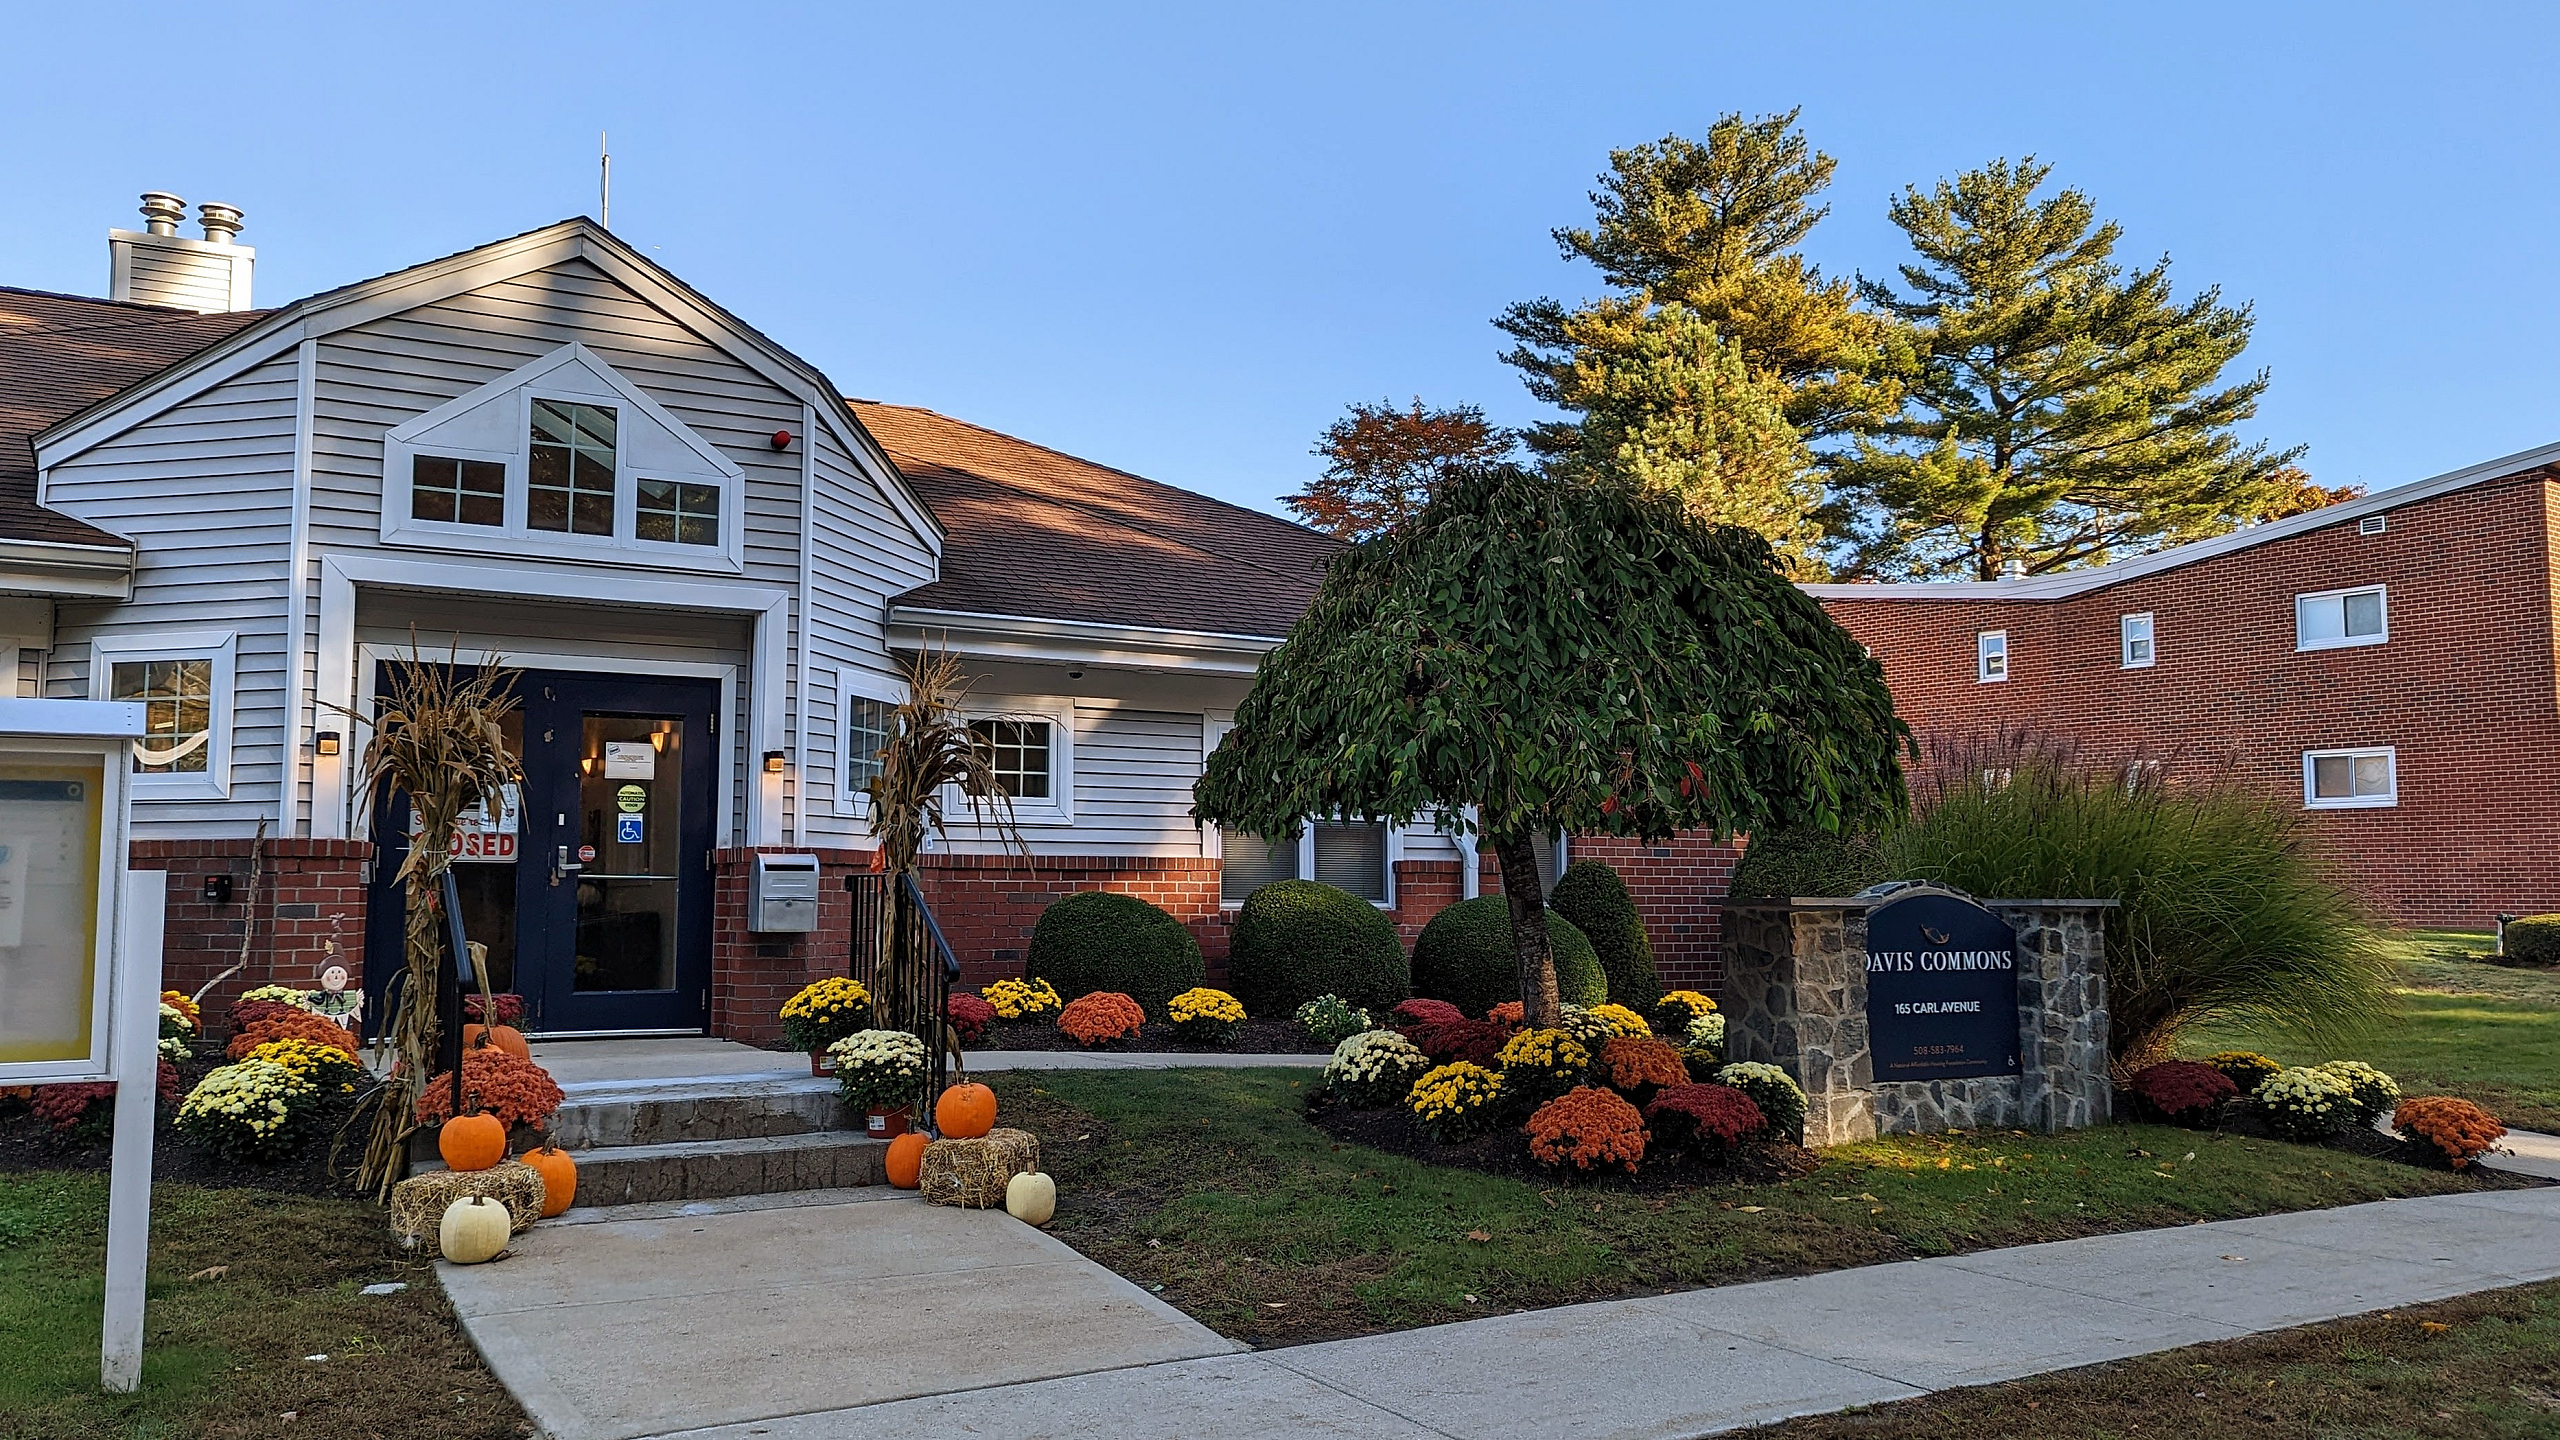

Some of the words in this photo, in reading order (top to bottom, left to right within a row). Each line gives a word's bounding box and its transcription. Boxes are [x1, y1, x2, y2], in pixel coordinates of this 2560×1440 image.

[1920, 950, 2012, 971] COMMONS
[1895, 1003, 1911, 1015] 165
[1912, 1002, 1940, 1014] CARL
[1940, 1001, 1981, 1013] AVENUE
[1913, 1045, 1965, 1055] 508-583-7964
